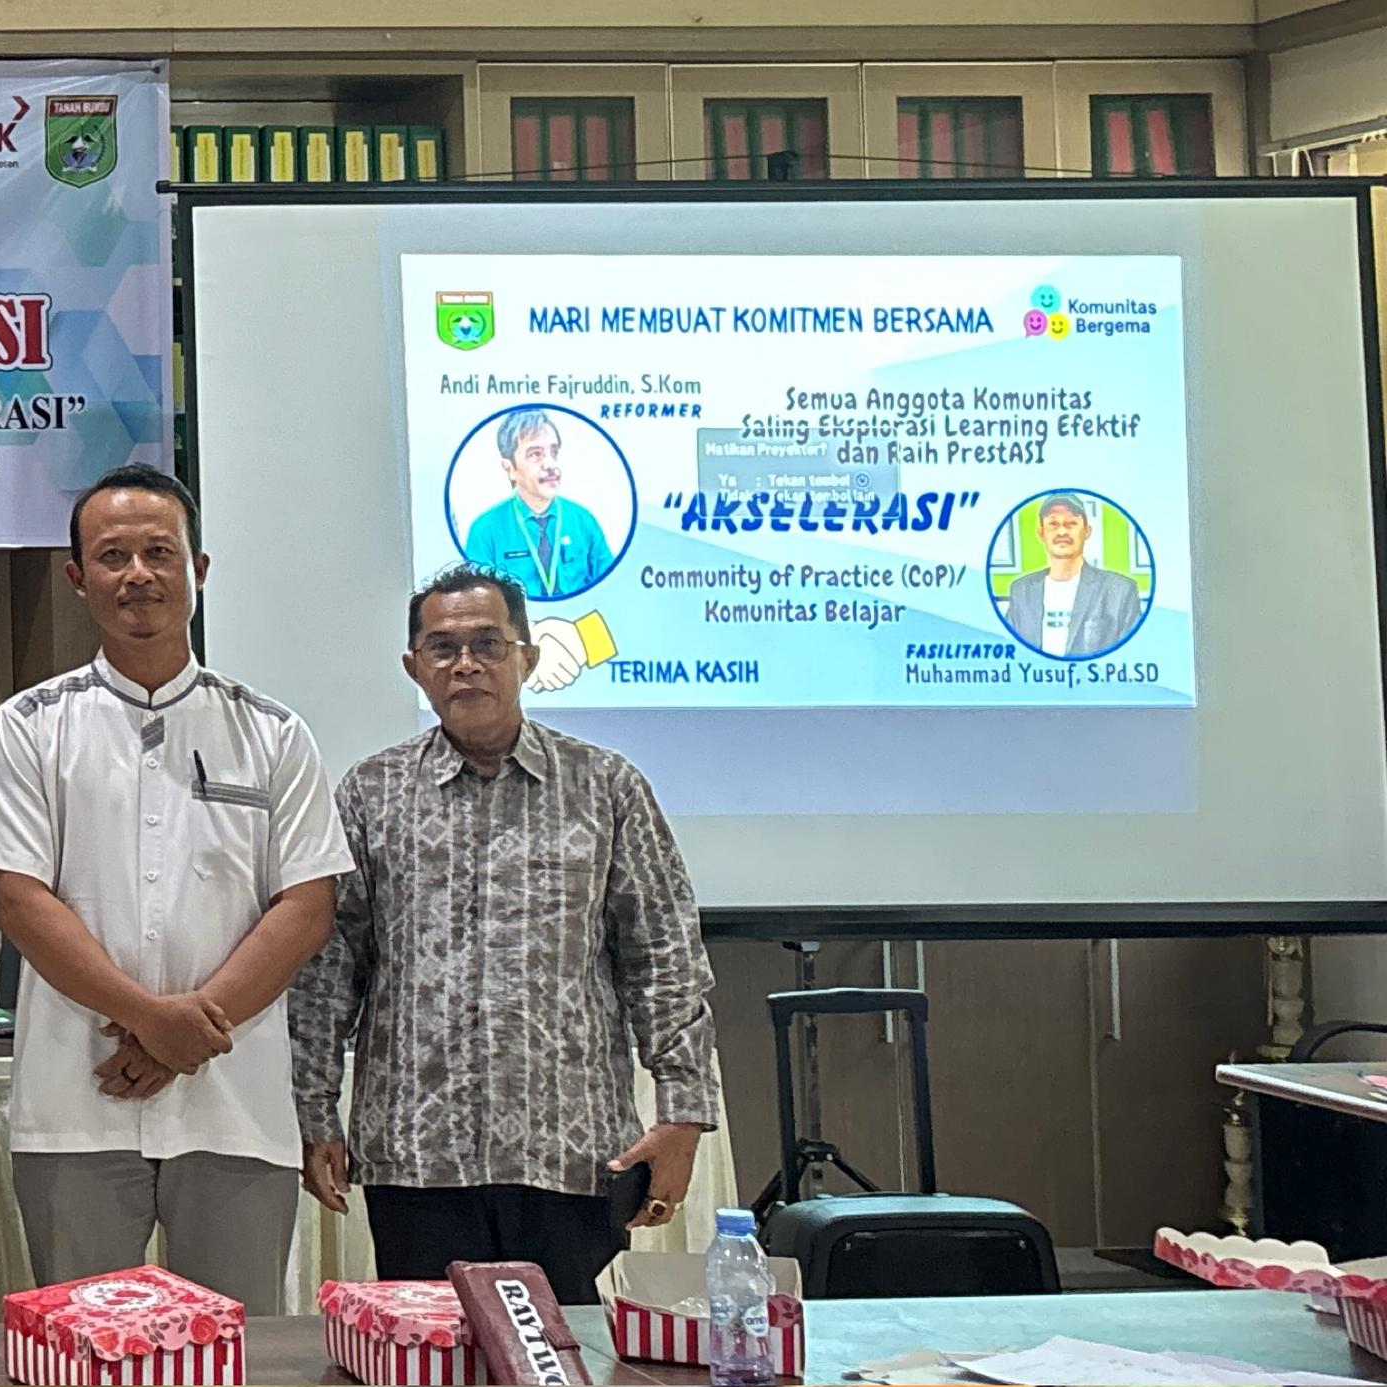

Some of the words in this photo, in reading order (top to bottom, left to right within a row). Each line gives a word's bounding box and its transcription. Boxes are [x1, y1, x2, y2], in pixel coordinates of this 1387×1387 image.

[54, 101, 82, 113] TANAH
[529, 306, 590, 333] MARI
[602, 306, 727, 334] MEMBUAT
[733, 306, 863, 334] KOMITMEN
[874, 306, 994, 334] BERSAMA
[1068, 299, 1157, 316] Komunitas
[1076, 319, 1151, 336] Bergema
[441, 374, 479, 394] Andi
[487, 374, 540, 394] Amrie
[548, 374, 635, 399] Fajruddin,
[641, 374, 702, 394] S.Kom
[600, 403, 702, 419] REFORMER
[786, 387, 858, 411] Semua
[866, 387, 966, 417] Anggota
[974, 387, 1093, 410] Komunitas
[741, 414, 810, 444] Saling
[819, 413, 936, 443] Eksplorasi
[945, 414, 1048, 444] Learning
[1057, 413, 1141, 438] Efektif
[837, 440, 879, 464] dan
[888, 440, 939, 464] Raih
[947, 439, 1046, 465] PrestASI
[640, 563, 761, 592] Community
[769, 563, 794, 588] of
[800, 564, 894, 589] Practice
[901, 564, 967, 590] (CoP)/
[704, 600, 818, 624] Komunitas
[826, 600, 908, 630] Belajar
[906, 642, 1016, 661] FASILITATOR
[609, 660, 689, 684] TERIMA
[695, 660, 760, 684] KASIH
[906, 663, 1011, 686] Muhammad
[1017, 663, 1081, 688] Yusuf,
[1087, 663, 1160, 684] S.Pd.SD
